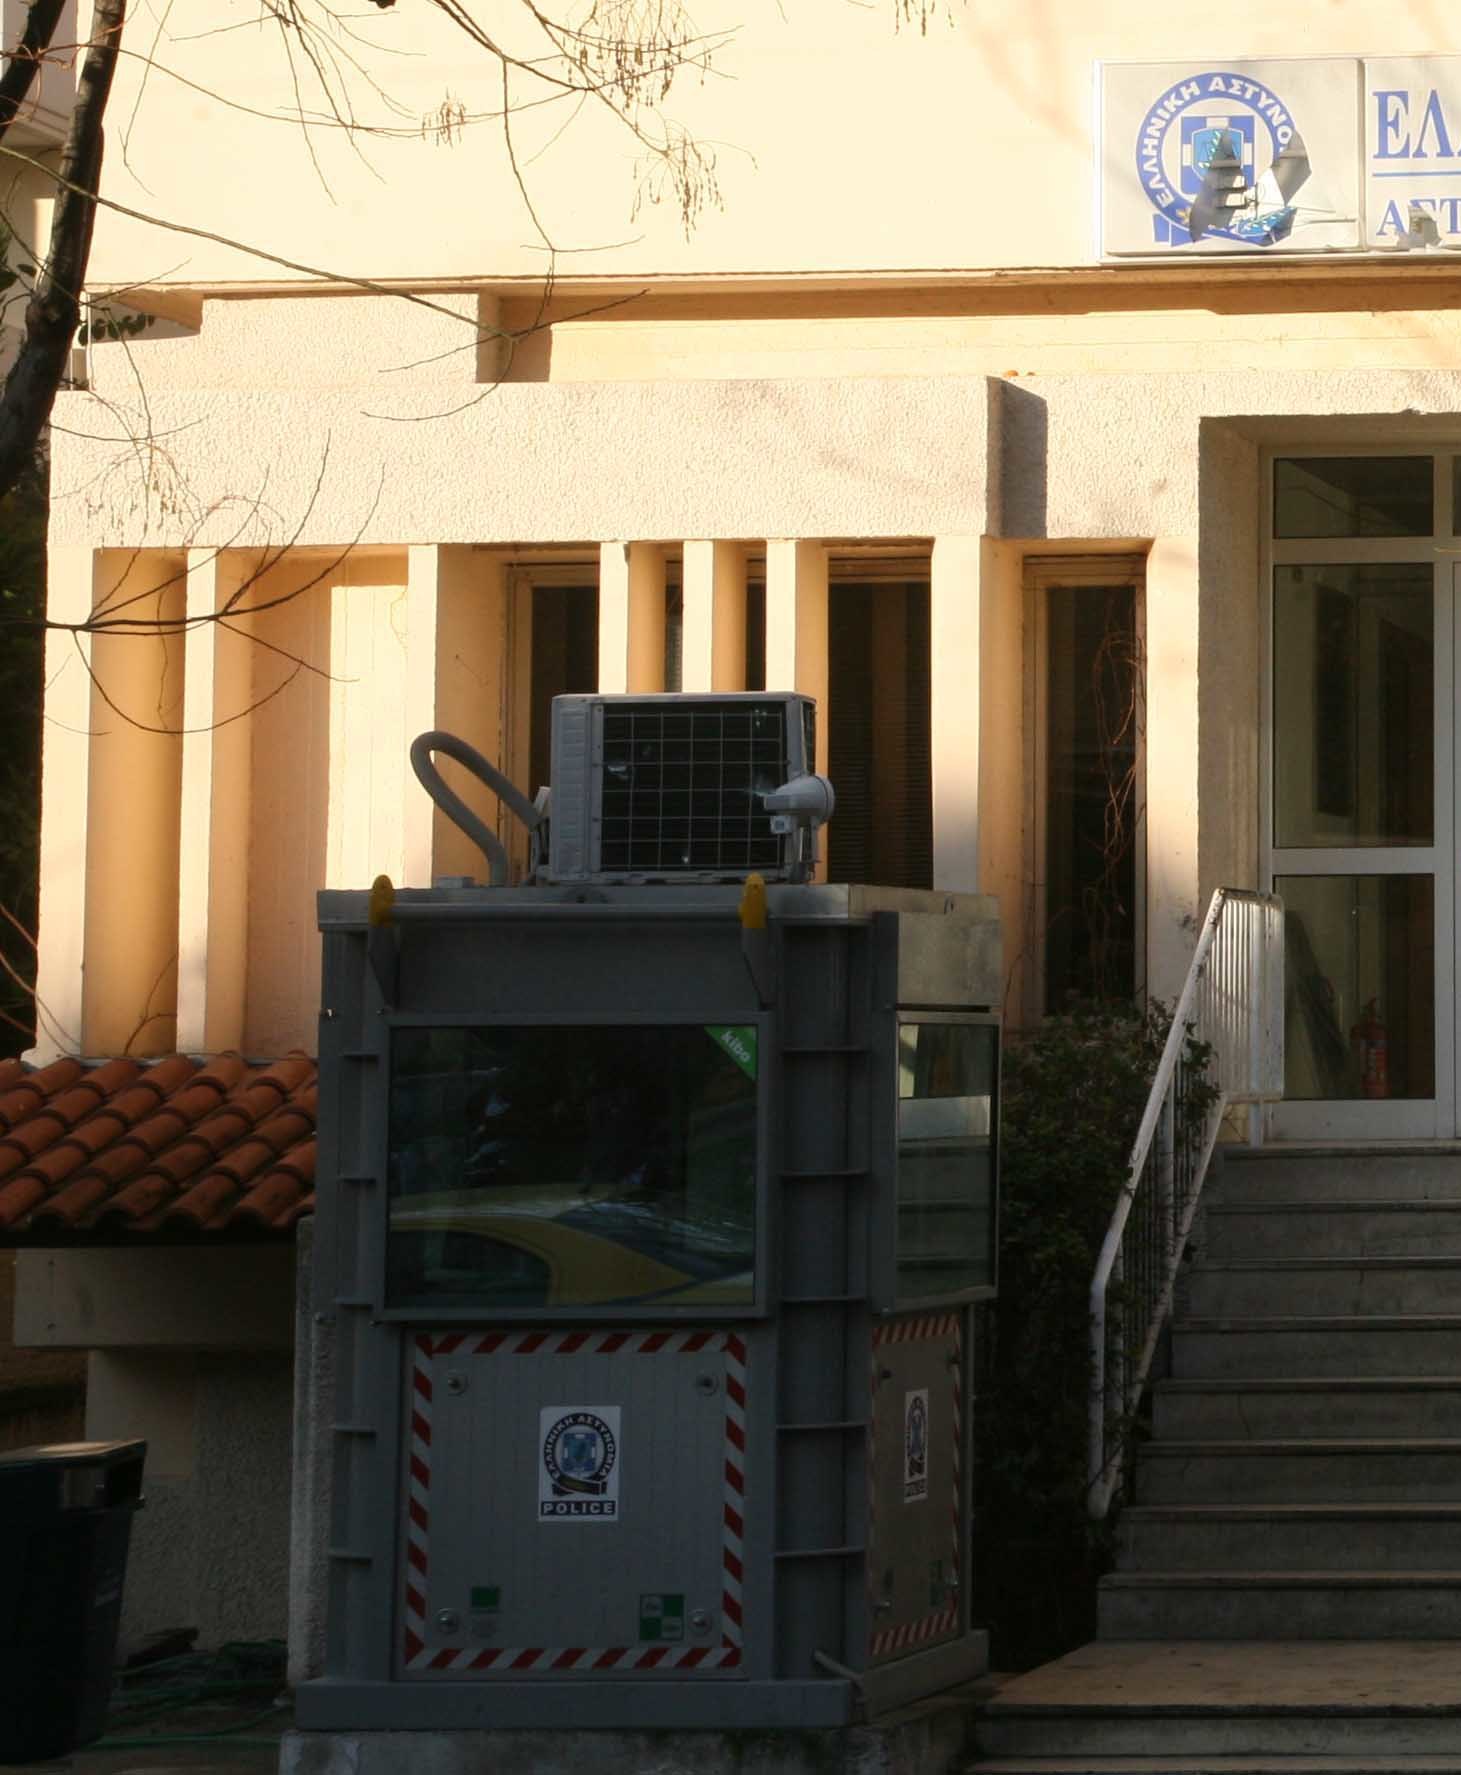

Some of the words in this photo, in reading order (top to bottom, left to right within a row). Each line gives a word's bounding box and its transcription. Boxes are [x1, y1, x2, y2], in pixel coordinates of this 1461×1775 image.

[1143, 81, 1201, 208] ΕΛΛΗΝΙΚΗ
[1208, 77, 1293, 153] ΑΣΤΥΝΟ
[543, 1502, 614, 1514] POLICE
